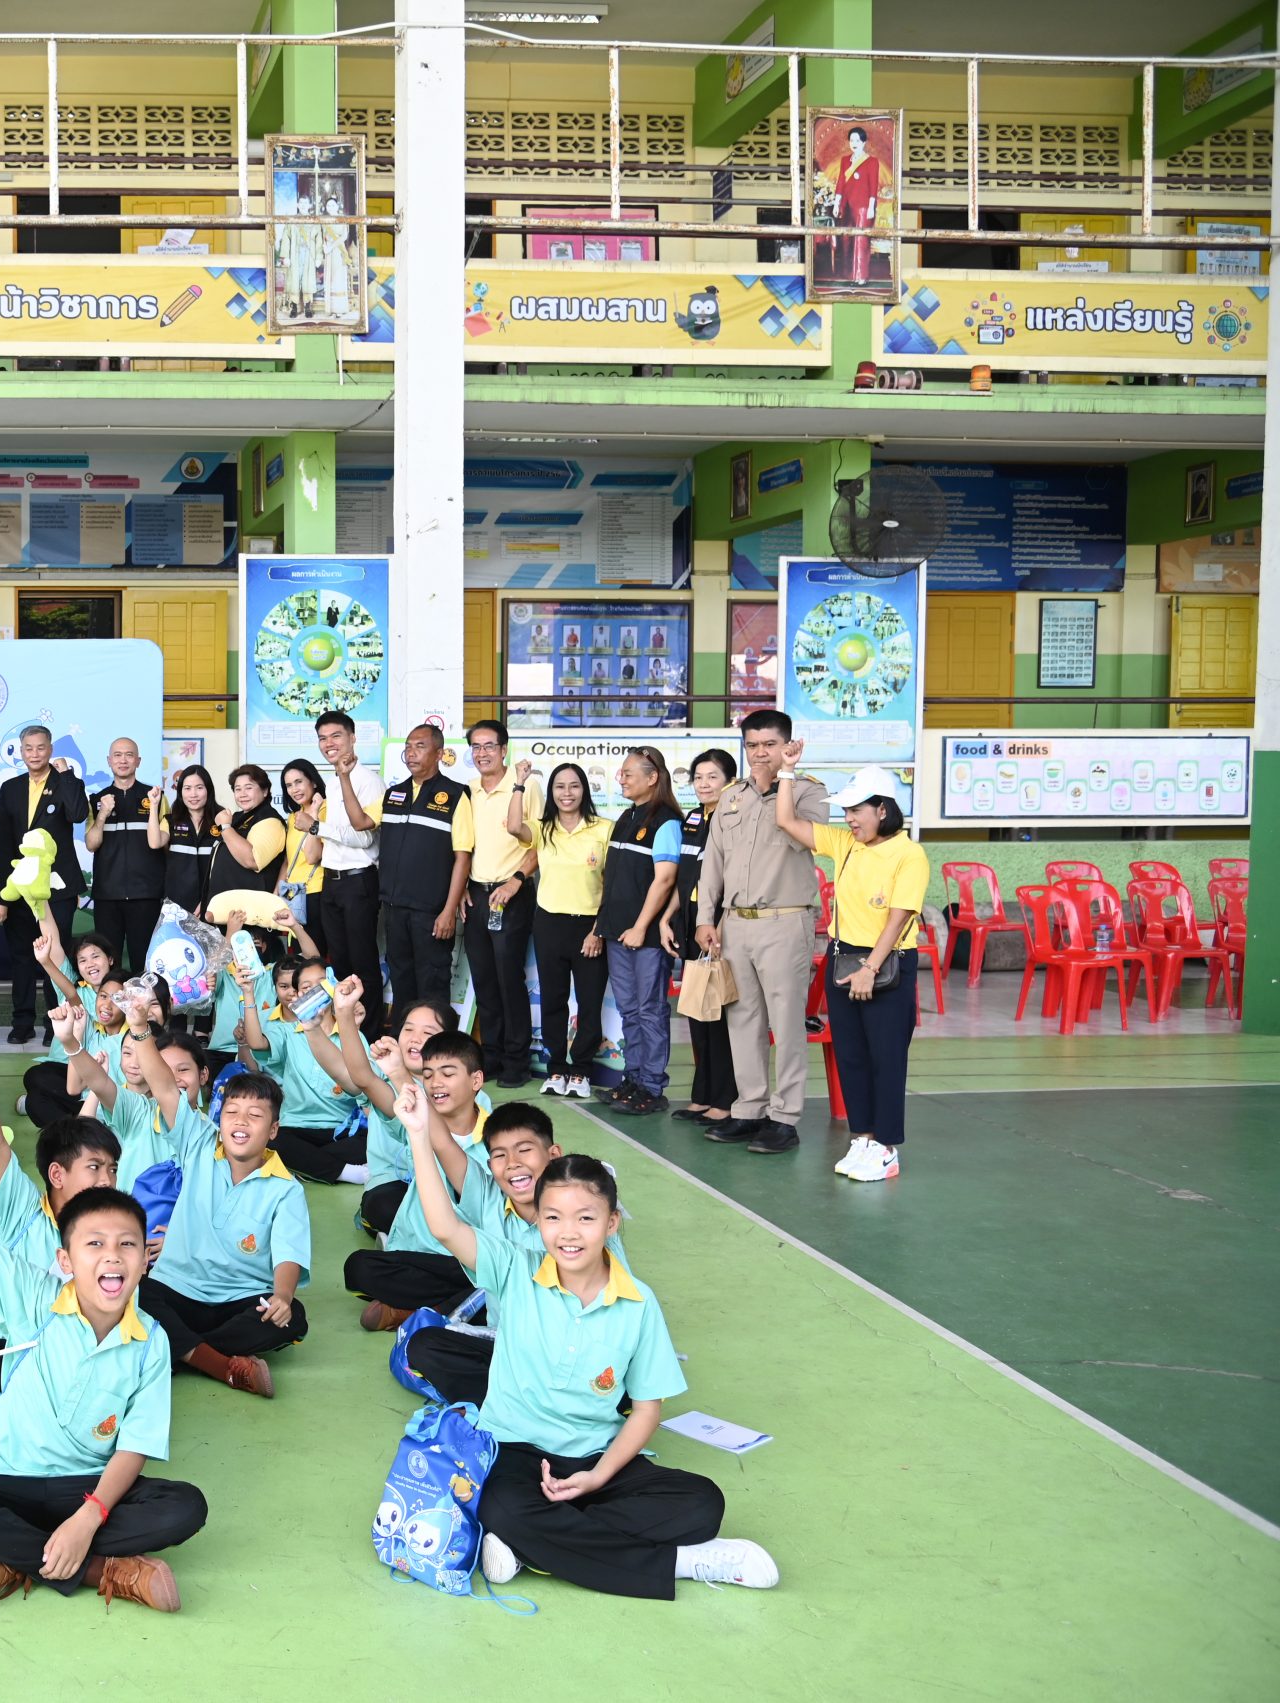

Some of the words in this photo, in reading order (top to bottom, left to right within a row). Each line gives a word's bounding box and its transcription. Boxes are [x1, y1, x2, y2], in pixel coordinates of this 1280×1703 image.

[510, 296, 667, 323] ผสมผสาน
[1025, 297, 1194, 344] แหล่งเรียนรู้
[955, 744, 988, 756] food
[992, 745, 1002, 755] &
[1008, 743, 1049, 756] drinks
